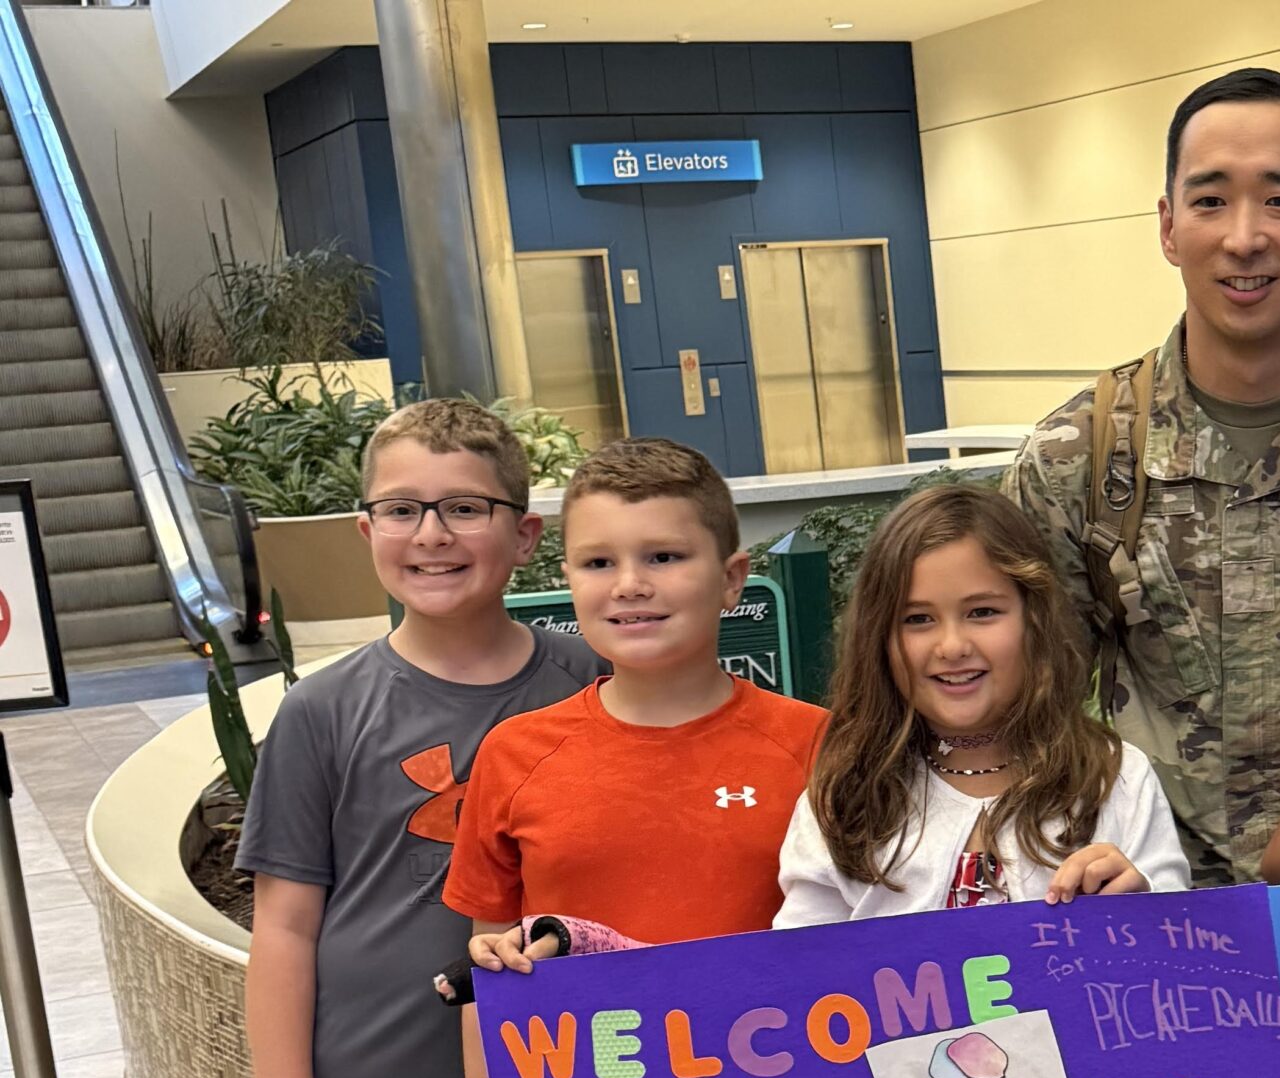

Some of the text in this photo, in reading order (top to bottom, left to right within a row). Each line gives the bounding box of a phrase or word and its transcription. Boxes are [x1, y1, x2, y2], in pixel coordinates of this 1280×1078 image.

[645, 153, 728, 171] Elevators
[1030, 917, 1080, 948] It
[1105, 914, 1137, 947] is
